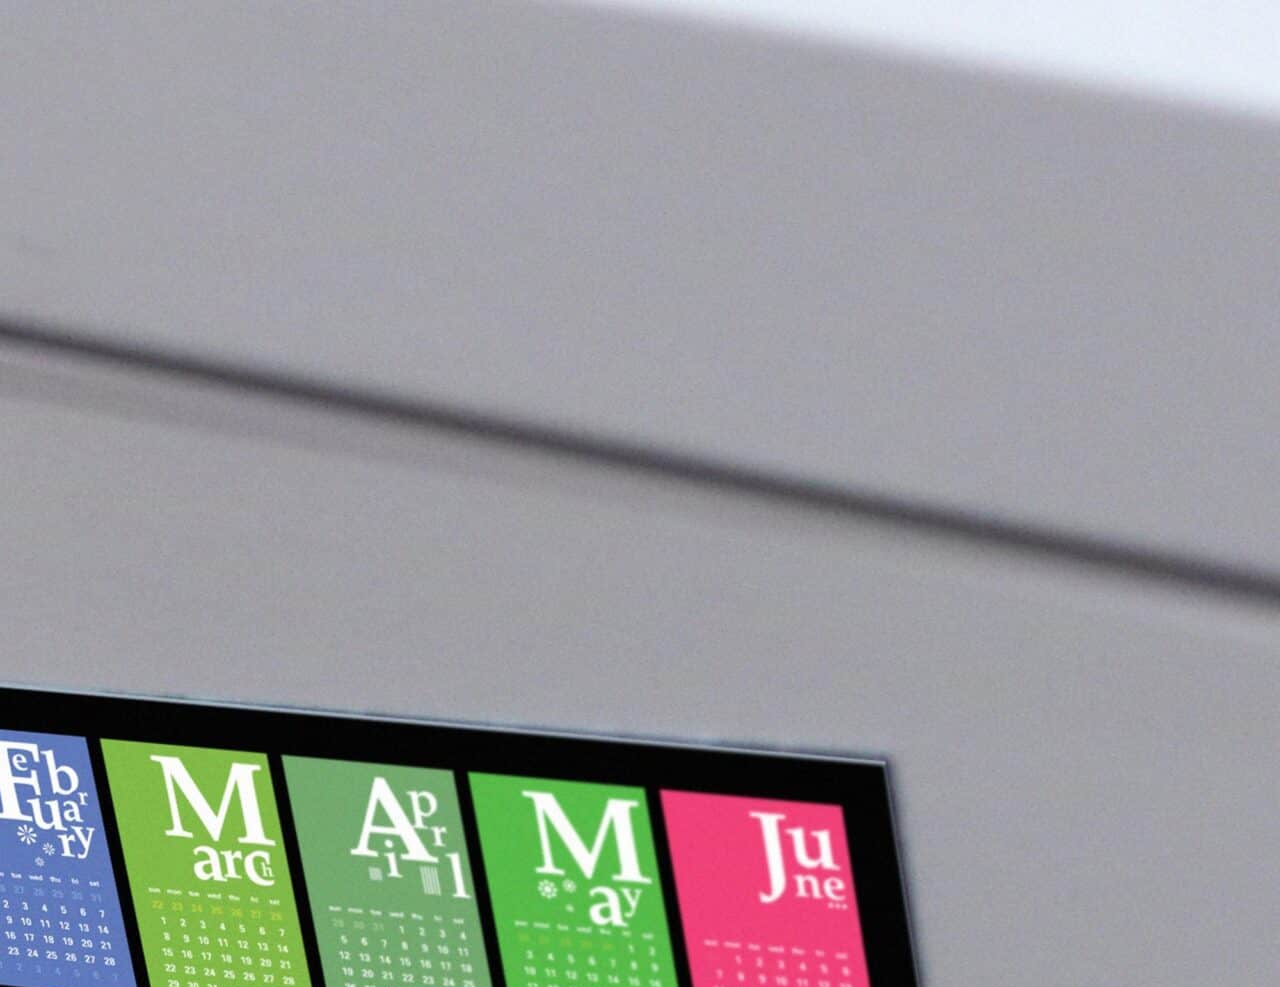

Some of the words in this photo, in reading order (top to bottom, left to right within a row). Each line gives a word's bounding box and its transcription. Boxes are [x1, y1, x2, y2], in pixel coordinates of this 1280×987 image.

[2, 899, 10, 909] 2
[21, 901, 29, 911] 3
[41, 903, 49, 913] 4
[59, 905, 68, 915] 5
[79, 907, 87, 917] 6
[98, 909, 105, 919] 7
[5, 915, 14, 925] 9
[20, 916, 33, 927] 10
[39, 919, 51, 929] 11
[58, 920, 71, 931] 12
[78, 923, 90, 933] 13
[97, 924, 110, 935] 14
[160, 915, 167, 925] 1
[179, 917, 187, 928] 2
[199, 919, 207, 930] 3
[219, 922, 227, 931] 4
[238, 923, 247, 934] 5
[258, 926, 267, 936] 6
[278, 927, 286, 937] 7
[163, 931, 171, 942] 8
[182, 933, 191, 944] 9
[197, 935, 211, 946] 10
[217, 937, 229, 948] 11
[236, 939, 249, 950] 12
[256, 941, 270, 952] 13
[276, 943, 289, 954] 14
